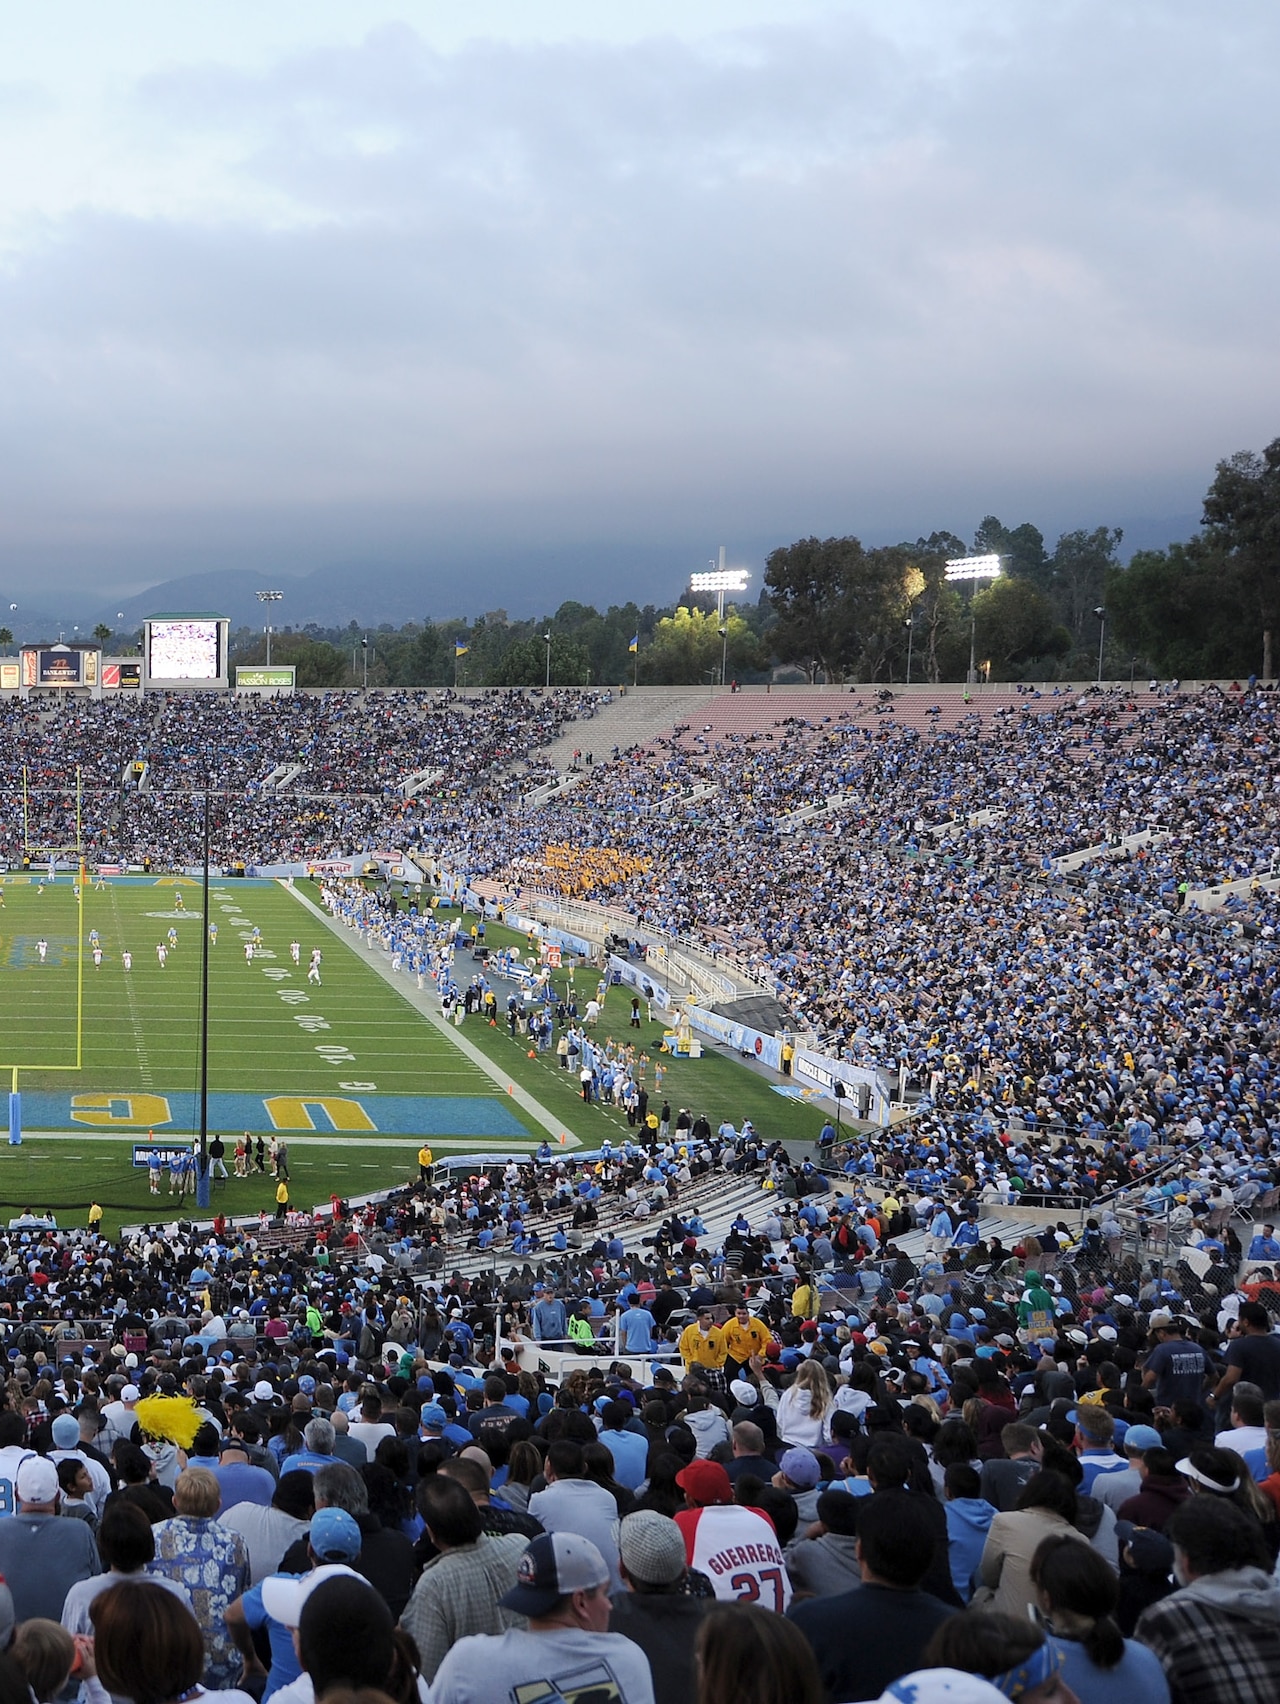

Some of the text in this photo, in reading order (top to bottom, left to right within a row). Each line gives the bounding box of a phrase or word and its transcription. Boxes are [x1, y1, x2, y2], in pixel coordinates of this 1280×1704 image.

[238, 678, 292, 686] PASSION ROSES
[293, 1015, 332, 1029] 20
[314, 1045, 356, 1060] 10
[707, 1543, 785, 1575] GUERRERO
[731, 1567, 785, 1614] 27
